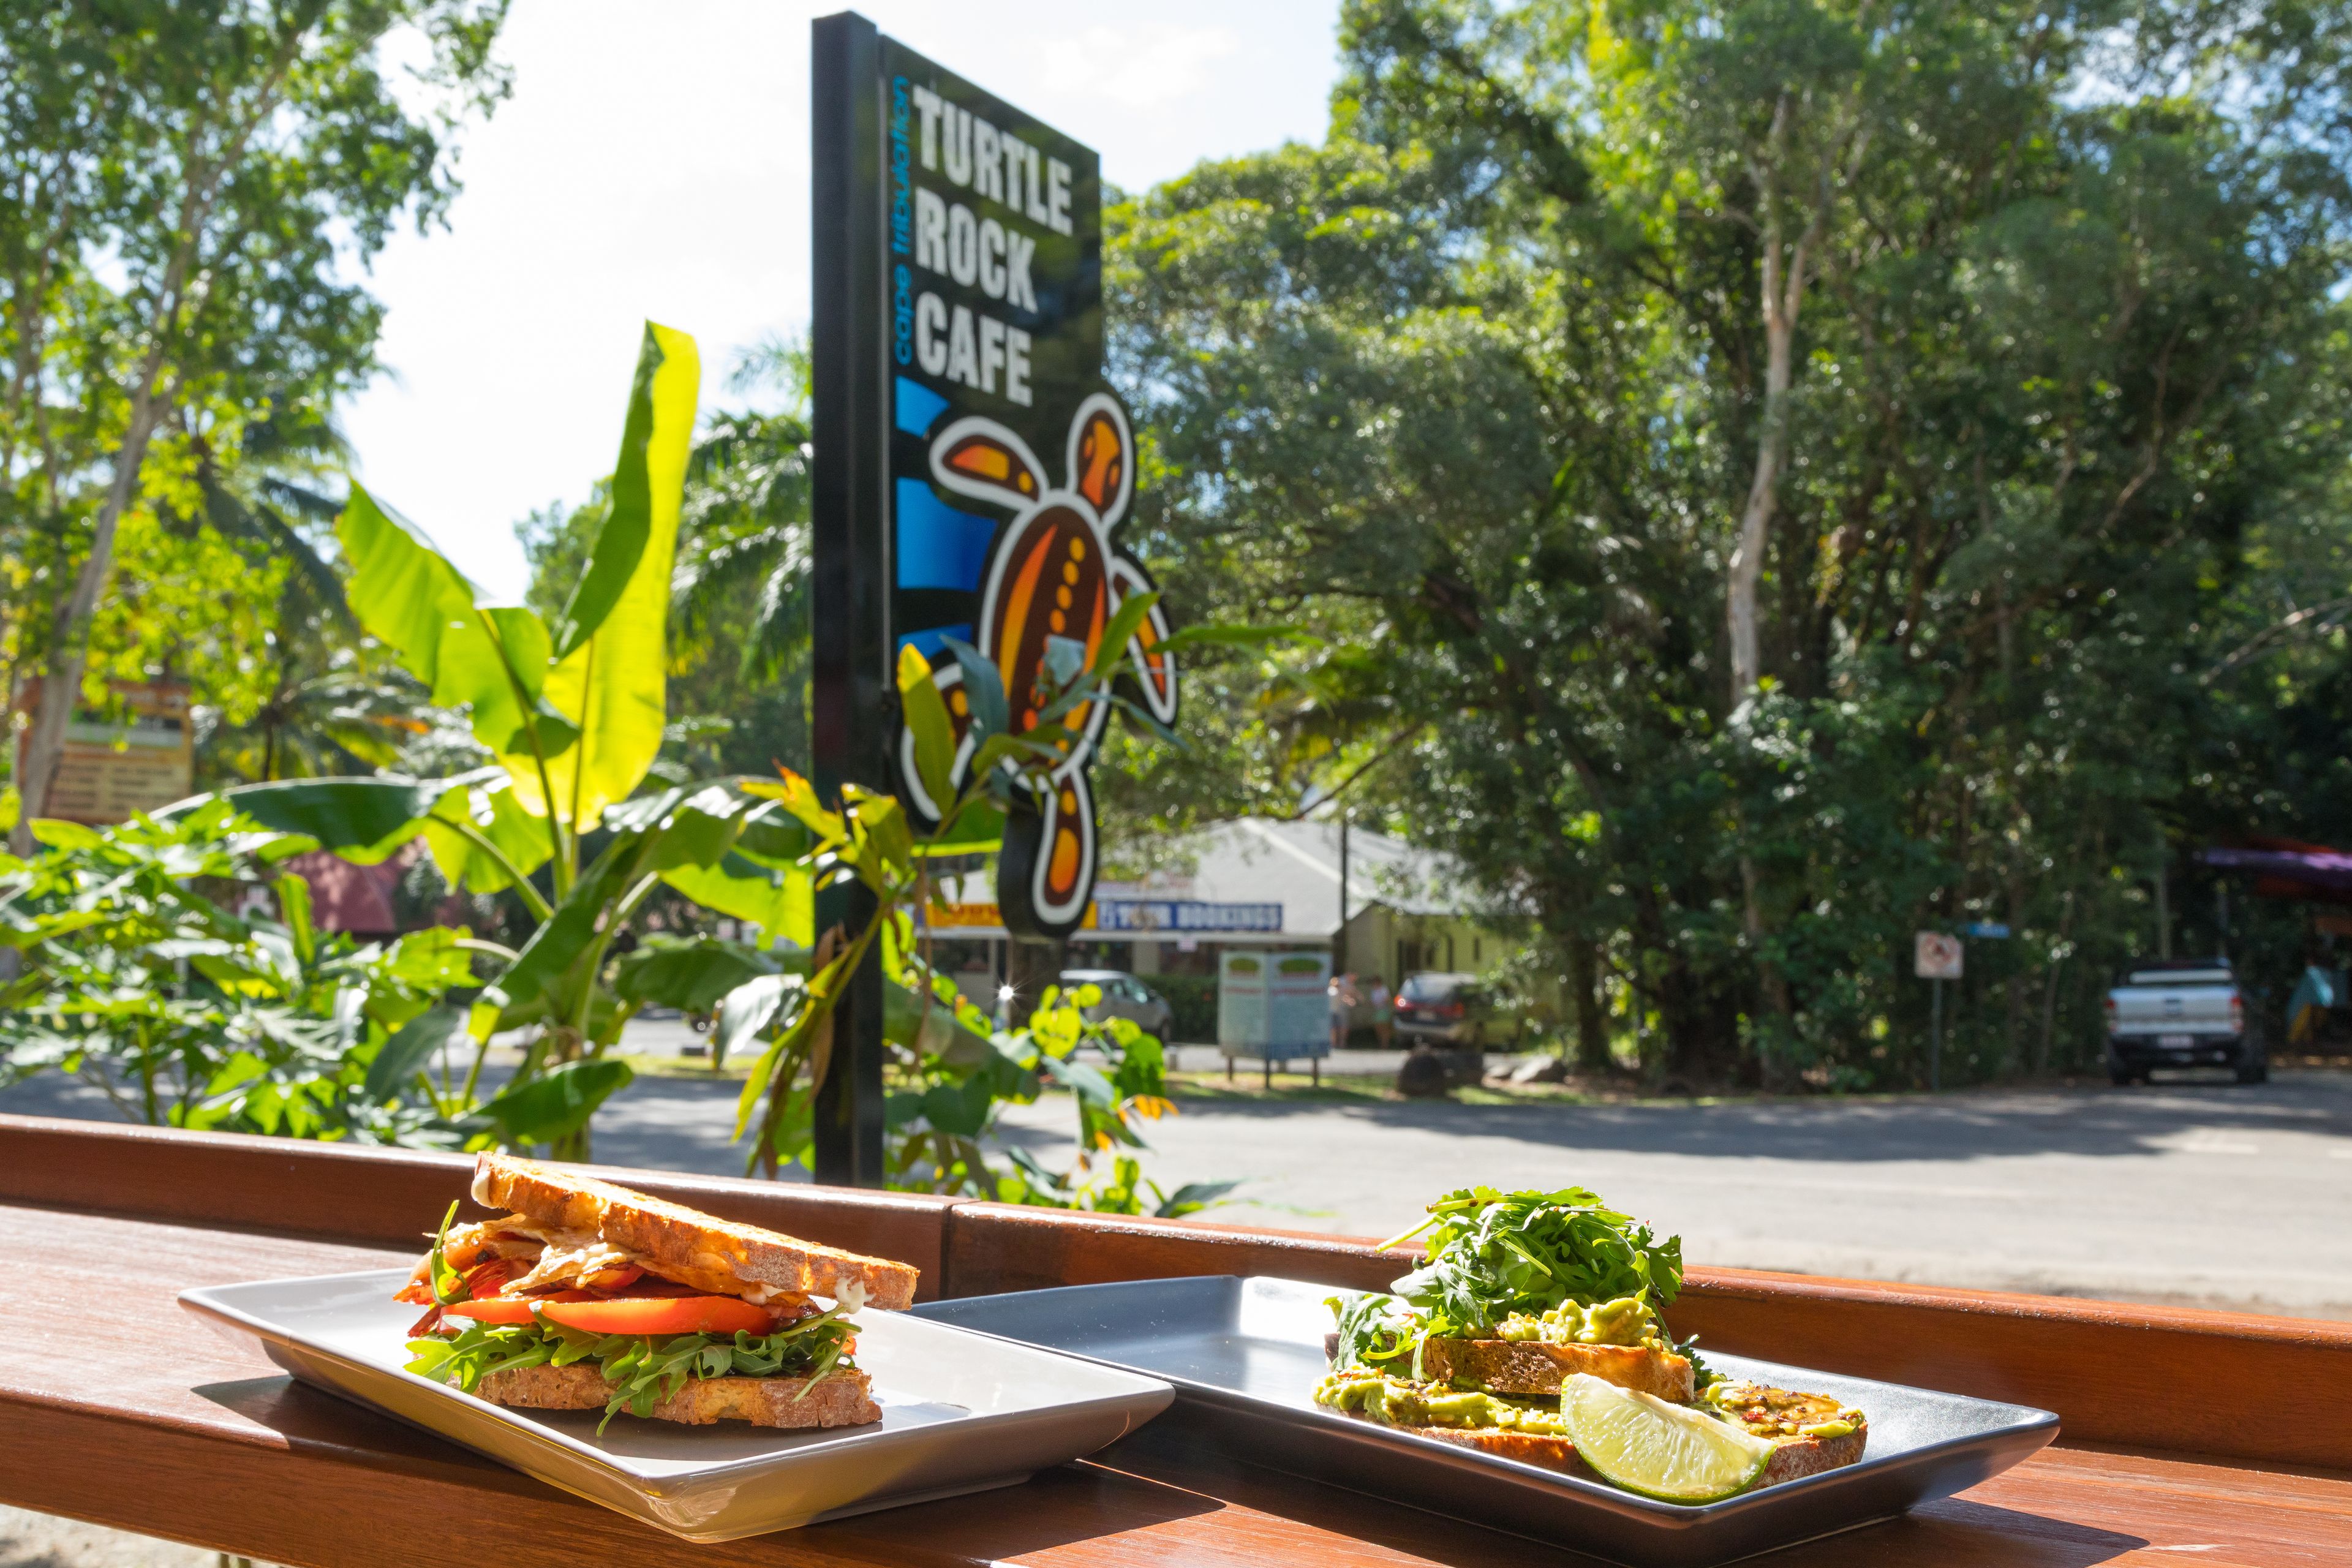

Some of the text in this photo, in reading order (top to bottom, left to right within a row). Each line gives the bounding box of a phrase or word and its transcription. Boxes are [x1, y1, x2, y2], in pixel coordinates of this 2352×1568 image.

[891, 75, 914, 365] cape tribulation
[913, 85, 1073, 236] TURTLE
[916, 186, 1038, 314] ROCK
[916, 291, 1033, 407] CAFE
